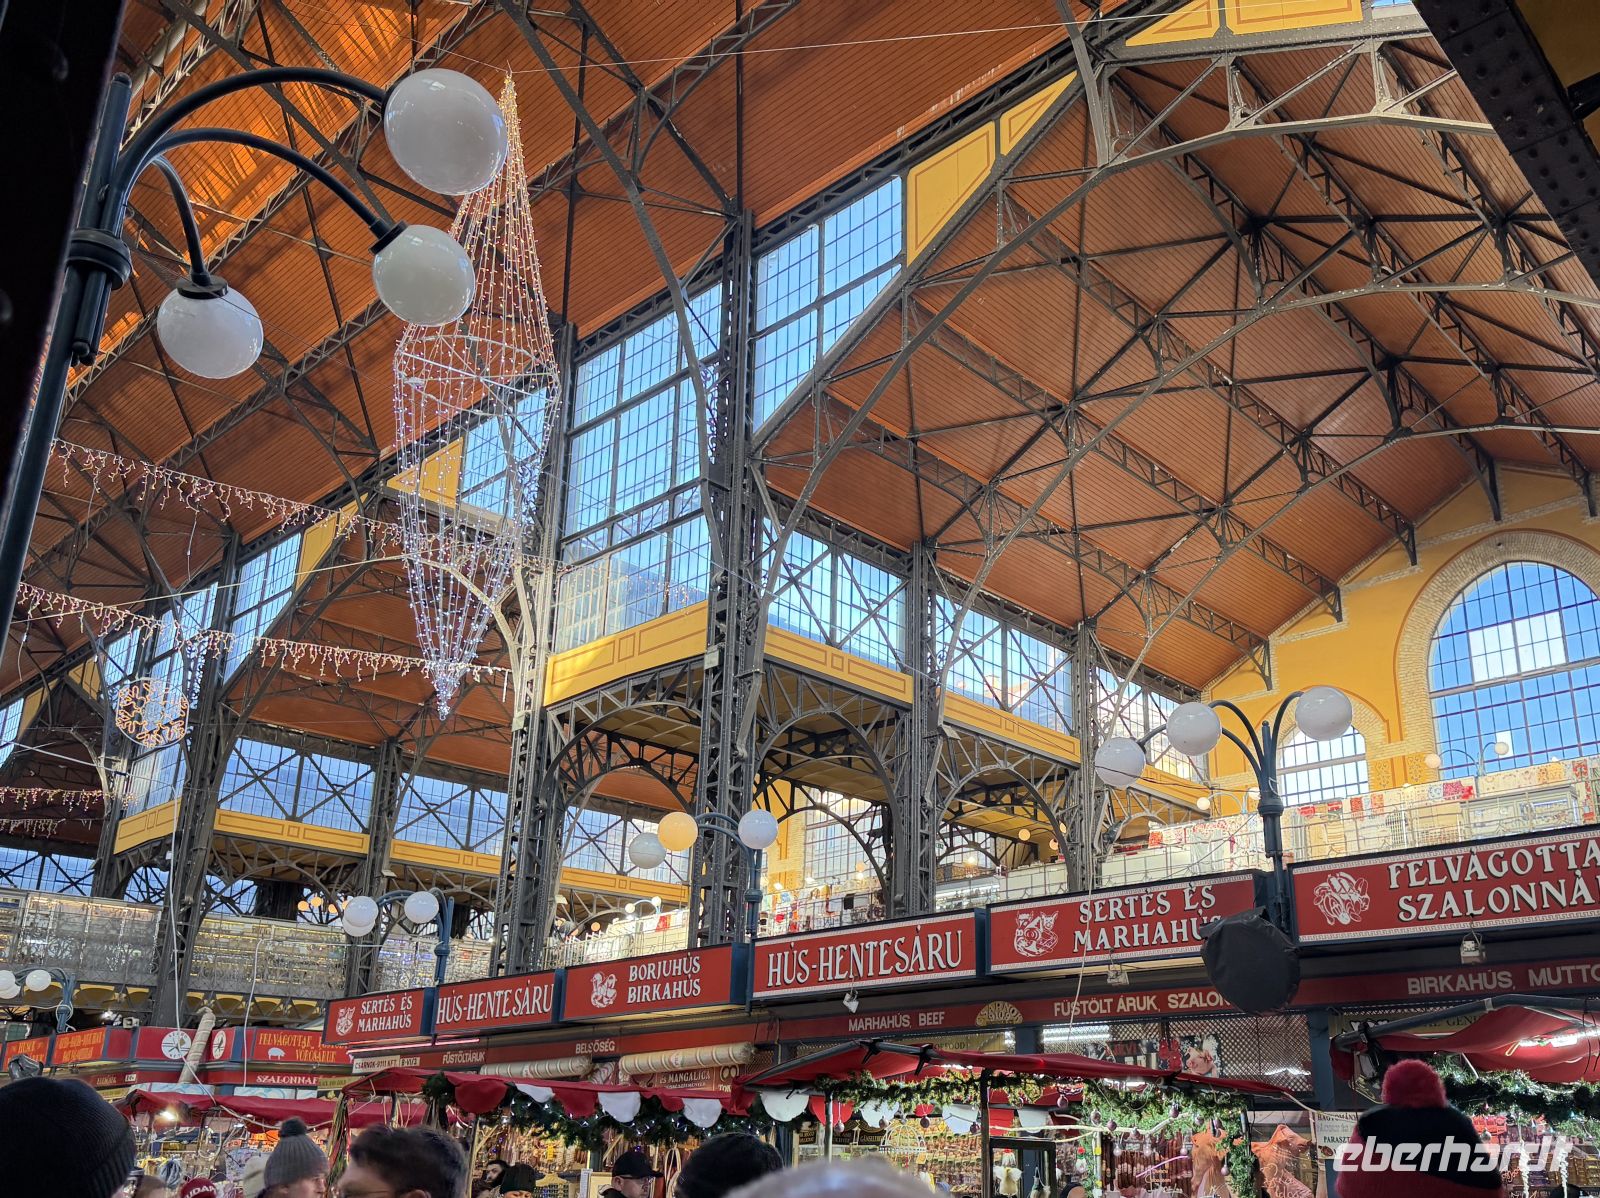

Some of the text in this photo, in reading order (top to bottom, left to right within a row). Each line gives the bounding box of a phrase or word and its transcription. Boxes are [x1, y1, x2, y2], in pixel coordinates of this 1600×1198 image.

[1079, 882, 1216, 924] SERTÉS ÉS
[1398, 869, 1600, 921] SZALONNÁ
[628, 952, 701, 982] BORJUHÚS
[768, 925, 962, 988] HÚS-HENTESÁRU
[627, 974, 701, 1004] BIRKAHÚS
[1407, 970, 1516, 995] BIRKAHÚS,
[361, 992, 413, 1015] SERTÉS ÉS
[357, 1010, 412, 1033] MARHAHÚS
[848, 1011, 946, 1032] MARHAHÚS, BEEF
[575, 1040, 616, 1055] BELSŐSÉG
[668, 1070, 711, 1084] MANGALICA
